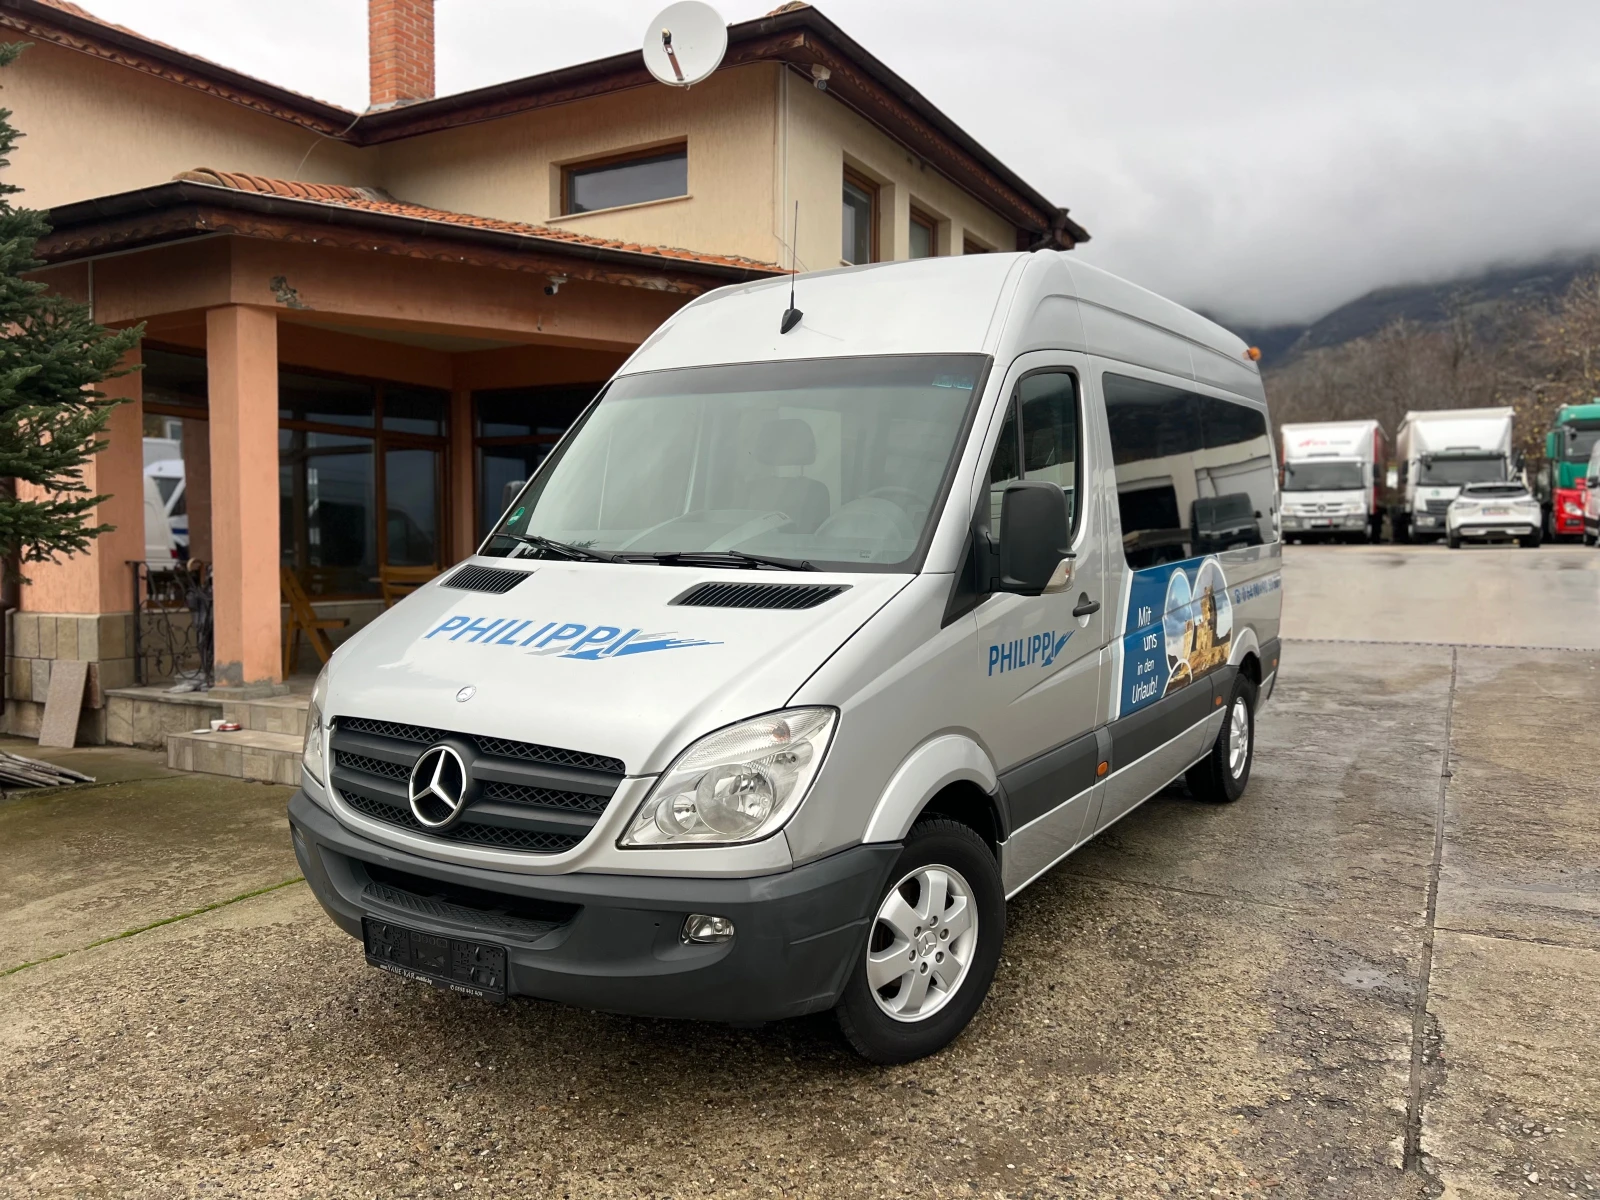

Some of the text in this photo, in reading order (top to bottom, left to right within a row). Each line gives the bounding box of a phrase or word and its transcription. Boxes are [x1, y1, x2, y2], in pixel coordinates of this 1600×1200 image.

[1138, 606, 1151, 628] Mit
[424, 615, 642, 657] PHILIPPI
[1143, 633, 1158, 651] uns
[988, 630, 1056, 676] PHILIPPI
[1137, 658, 1154, 676] in den
[1131, 675, 1158, 704] Urlaub!
